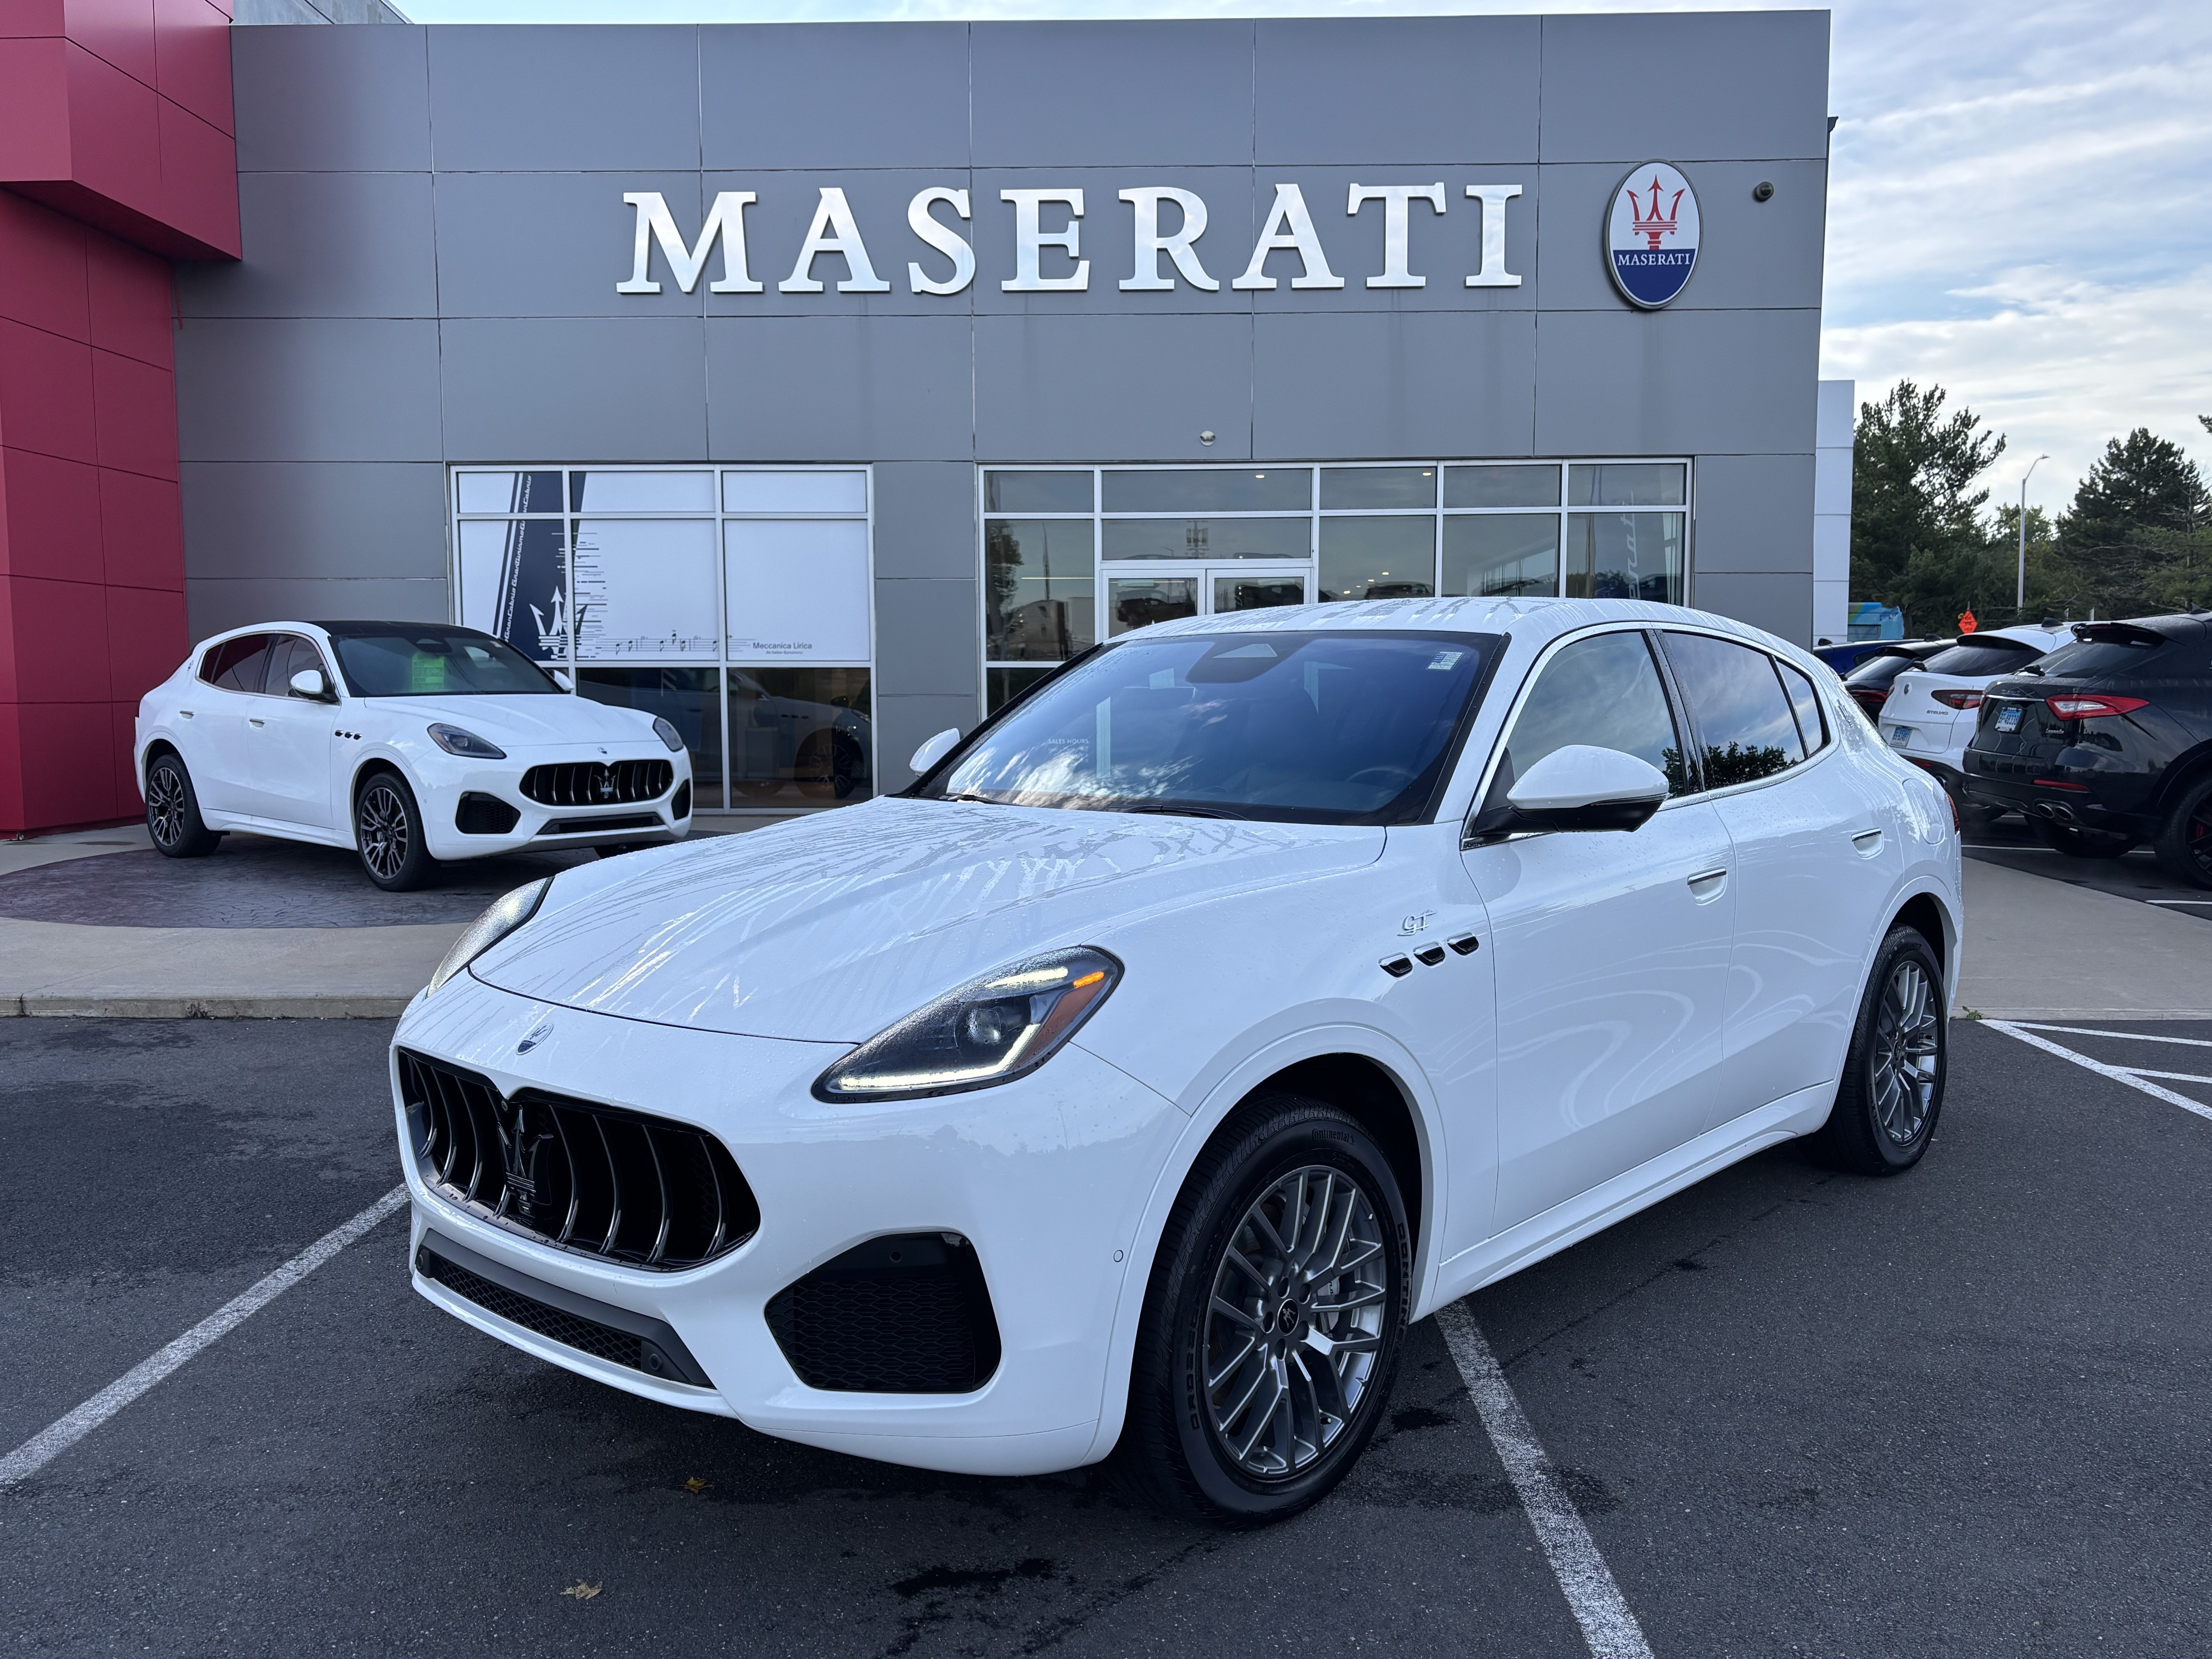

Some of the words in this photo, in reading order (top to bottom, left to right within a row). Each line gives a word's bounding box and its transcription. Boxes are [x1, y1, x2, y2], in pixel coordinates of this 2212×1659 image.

[617, 182, 1523, 295] MASERATI
[1617, 253, 1690, 266] MASERATI
[1397, 909, 1438, 936] GT
[1312, 1128, 1350, 1143] Continental
